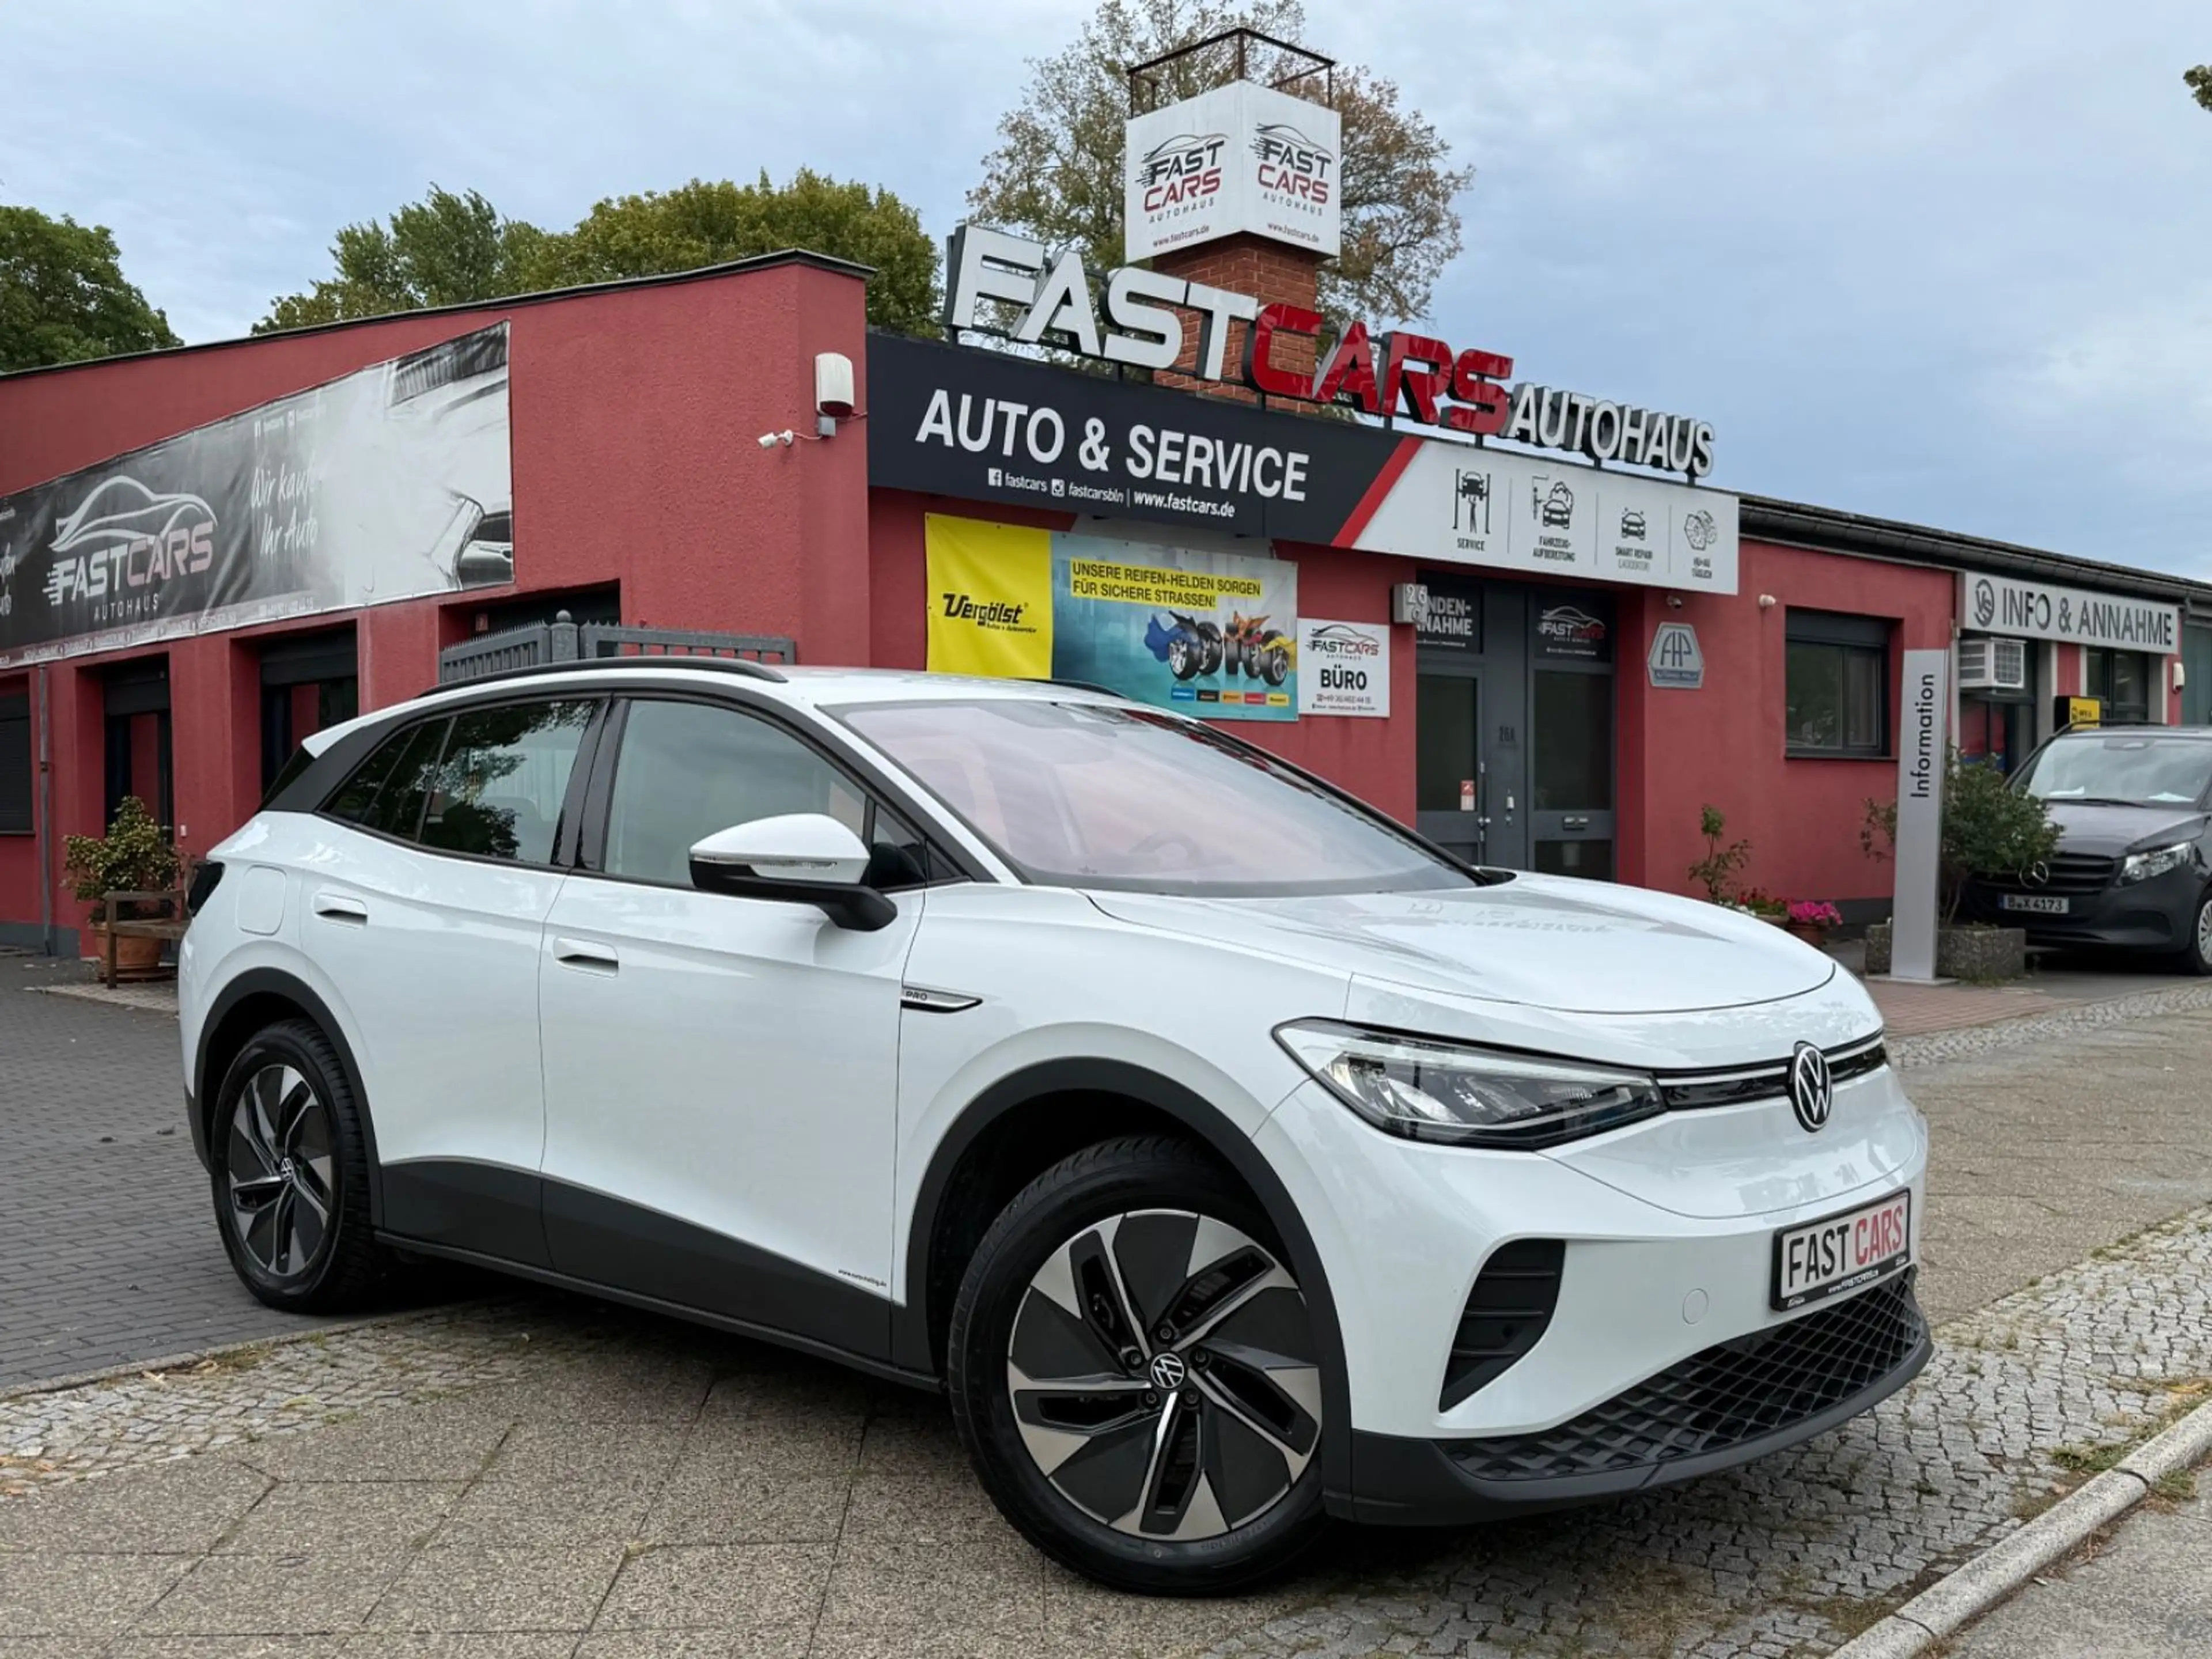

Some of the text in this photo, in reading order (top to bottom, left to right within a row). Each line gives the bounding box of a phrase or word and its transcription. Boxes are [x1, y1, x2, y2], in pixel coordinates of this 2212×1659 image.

[1147, 140, 1225, 186] FAST
[1262, 137, 1332, 179] FAST
[1144, 167, 1222, 212] CARS
[1257, 164, 1329, 204] CARS
[1149, 196, 1215, 224] AUTOHAUS
[1263, 191, 1323, 217] AUTOHAUS
[1152, 224, 1210, 248] www.fastcars.de
[1267, 222, 1320, 243] www.fastcars.de
[915, 388, 1310, 502] AUTO & SERVICE
[1508, 382, 1715, 478] AUTOHAUS
[1005, 472, 1236, 518] fastcars fastcarsbln www.fastcars.de
[1072, 561, 1261, 597] UNSERE REIFEN-HELDEN SORGEN
[1073, 578, 1216, 608] FÜR SICHERE STRASSEN!
[93, 592, 160, 622] AUTOHAUS
[942, 592, 1024, 627] Vergölst
[1427, 596, 1471, 616] NDEN-
[2002, 587, 2051, 631] INFO
[2058, 596, 2073, 634] &
[2077, 600, 2172, 646] ANNAHME
[1320, 663, 1368, 691] BÜRO
[1910, 673, 1936, 798] Information
[905, 990, 927, 1001] PRO
[1789, 1205, 1903, 1289] FAST CARS
